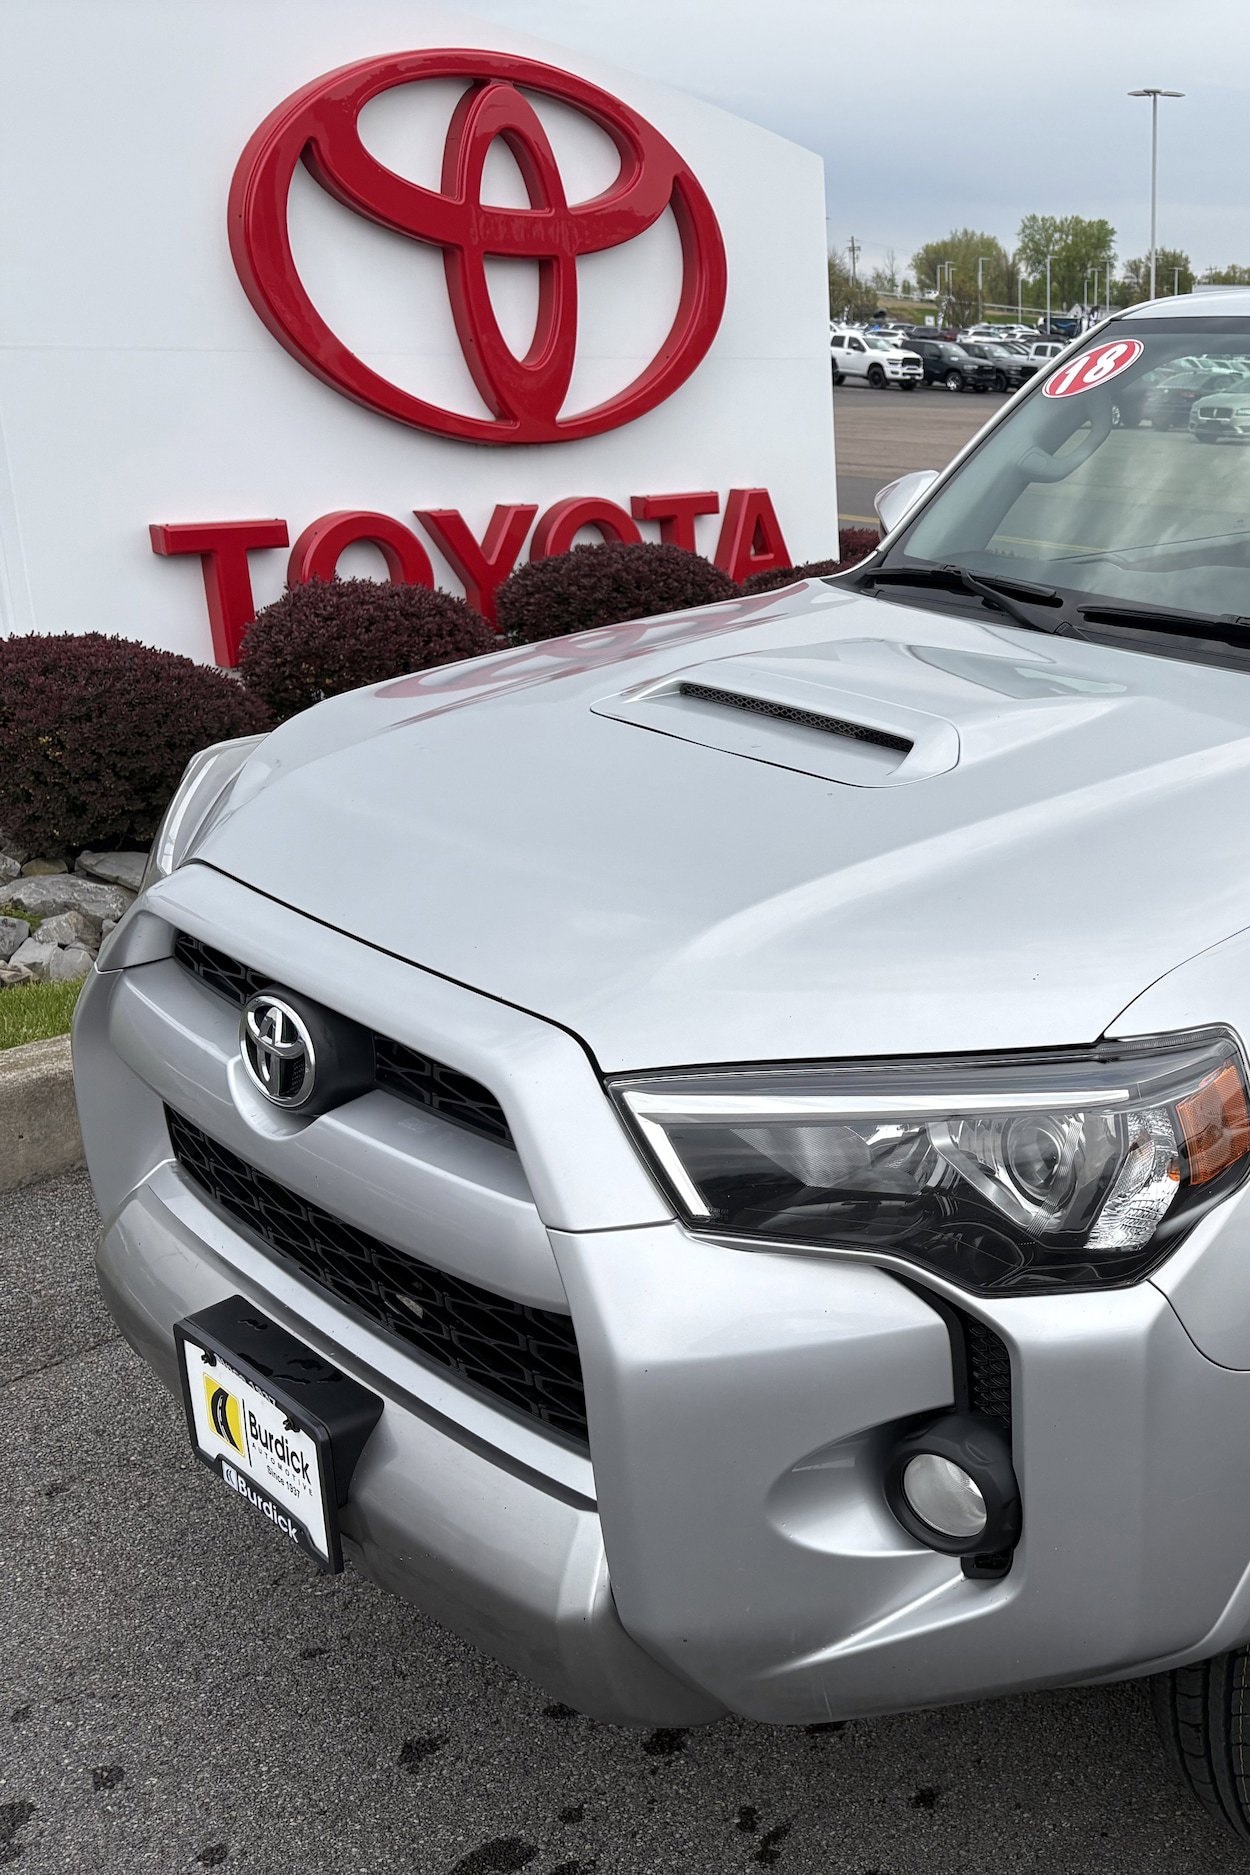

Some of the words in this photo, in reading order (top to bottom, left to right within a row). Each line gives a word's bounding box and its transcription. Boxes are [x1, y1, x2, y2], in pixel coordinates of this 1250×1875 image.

[1055, 343, 1129, 395] 18
[149, 487, 794, 668] TOYOTA
[248, 1410, 312, 1486] Burdick
[252, 1443, 313, 1496] AUTOMOTIVE
[238, 1474, 299, 1543] Burdick
[266, 1465, 285, 1486] Since
[285, 1481, 300, 1499] 1937
